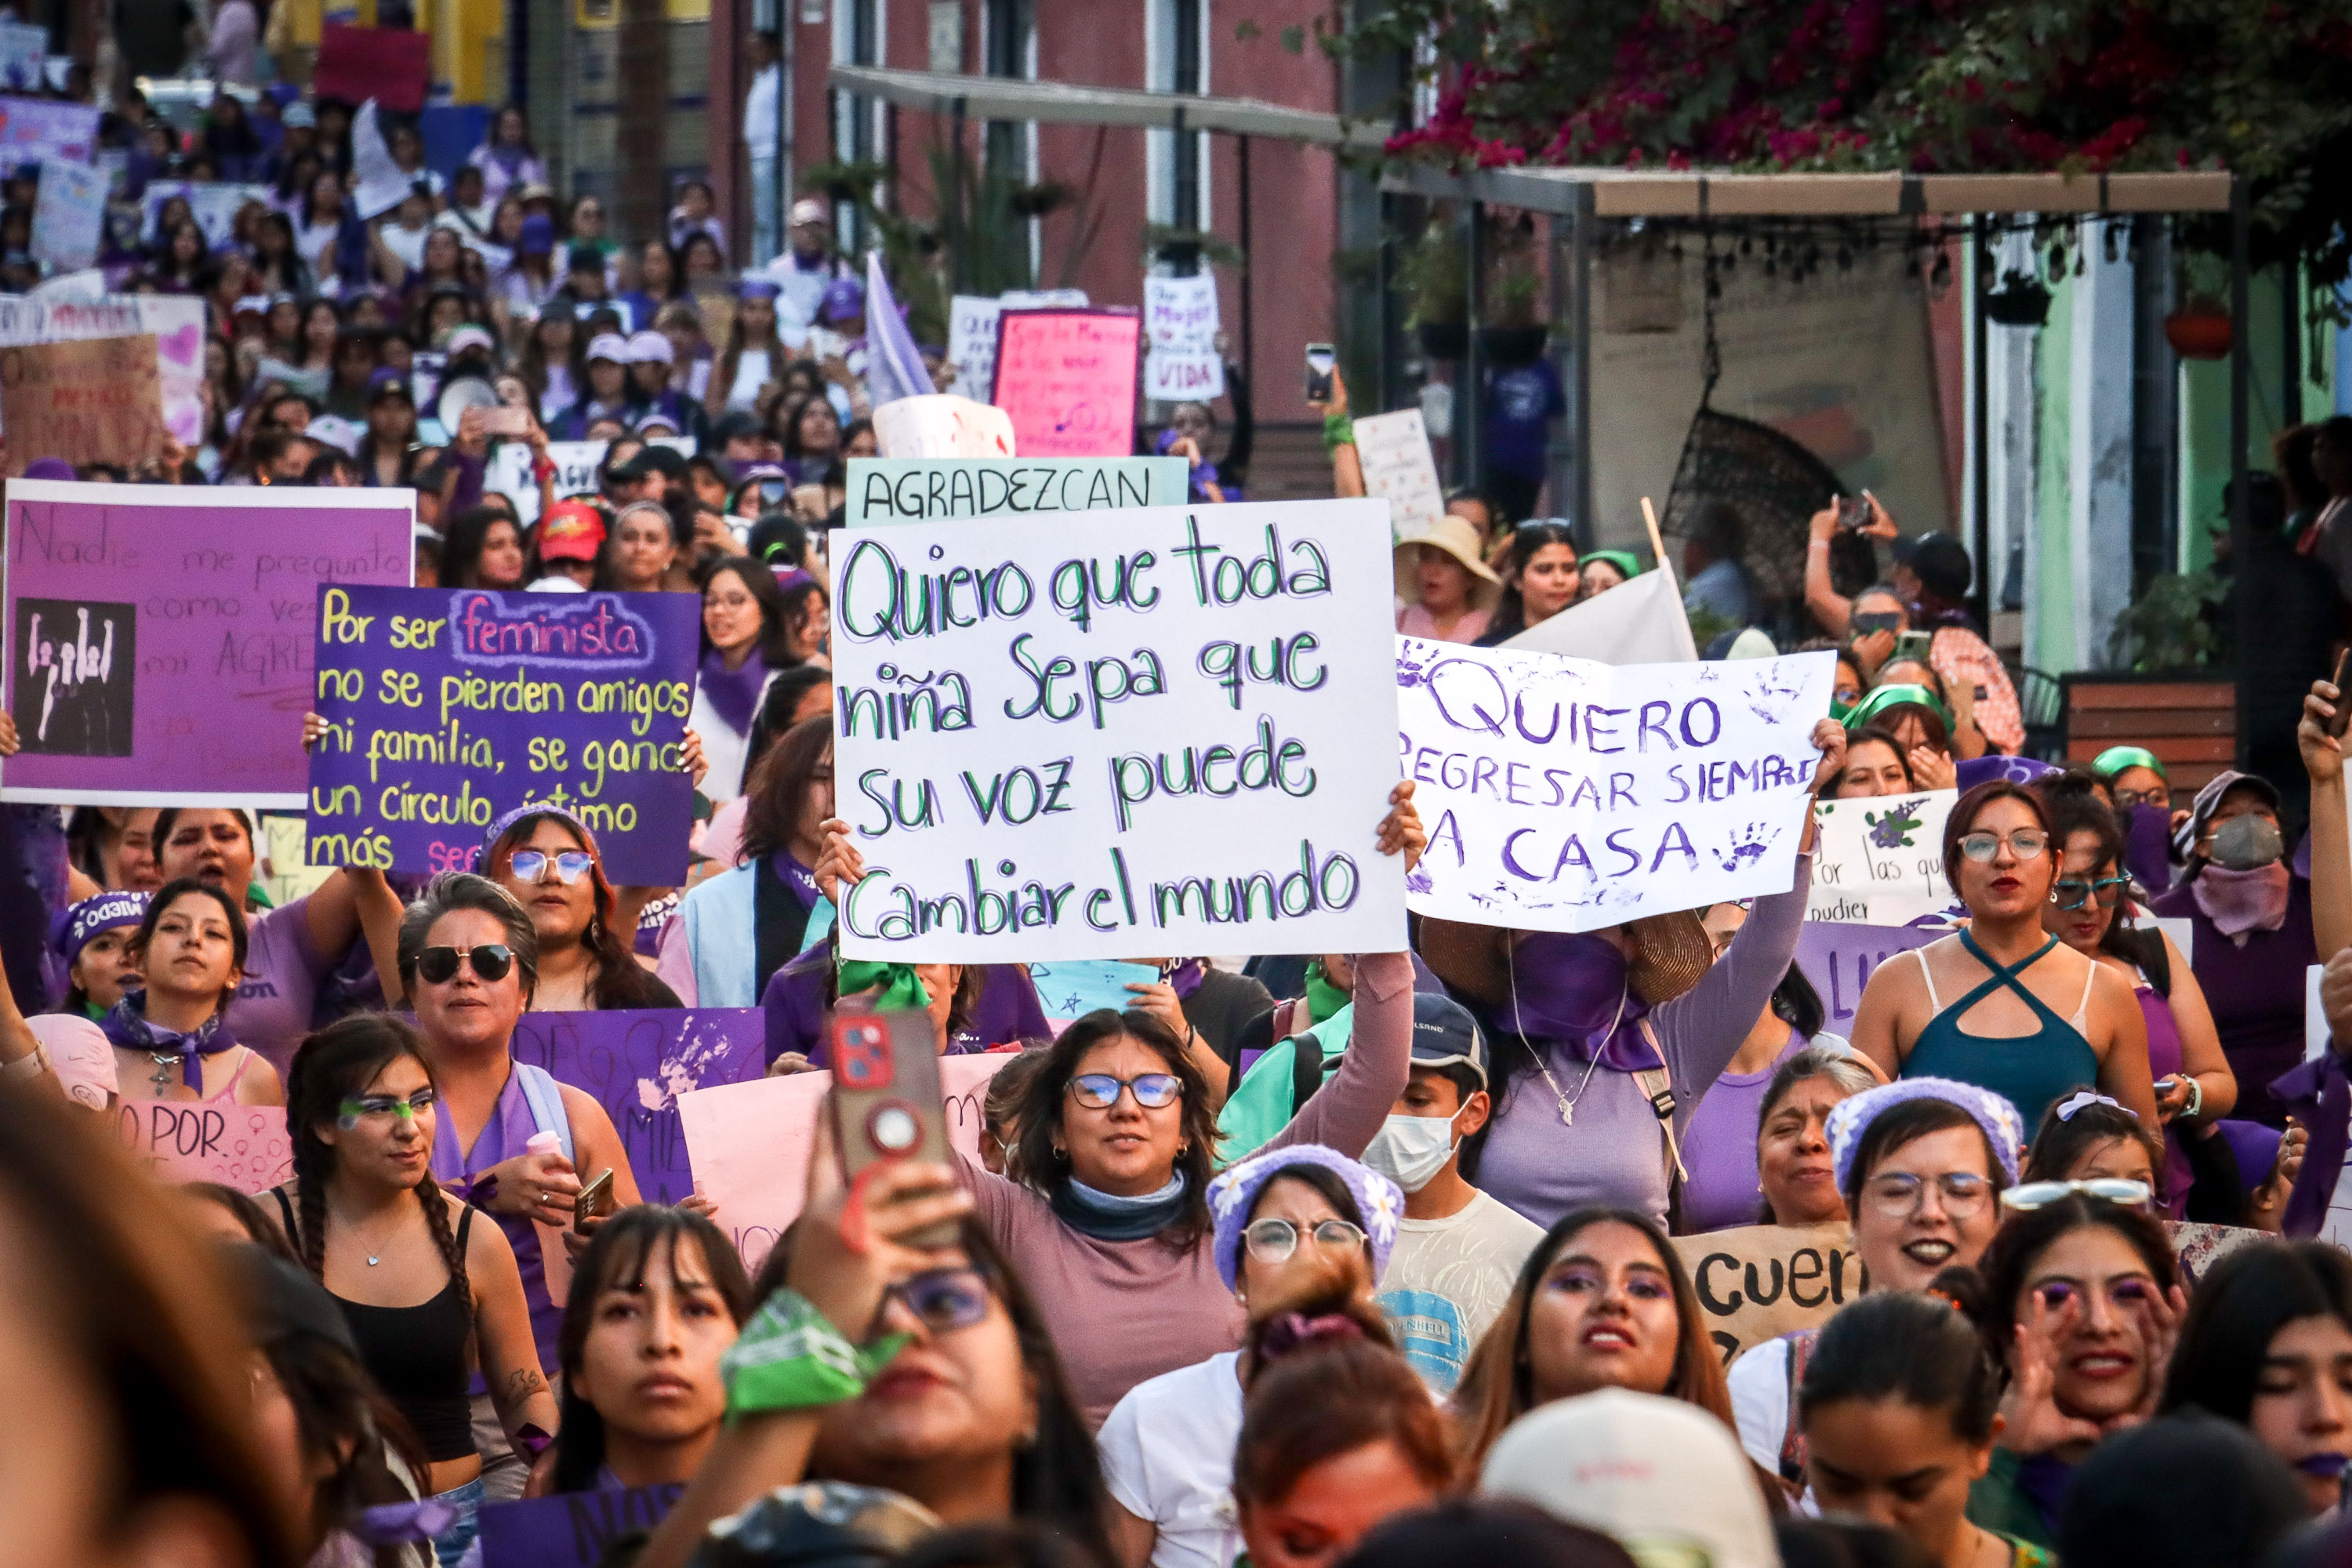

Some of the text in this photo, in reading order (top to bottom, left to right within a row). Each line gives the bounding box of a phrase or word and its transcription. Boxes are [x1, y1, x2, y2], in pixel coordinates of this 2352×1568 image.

[1157, 362, 1211, 390] VIDA
[863, 467, 1150, 519] AGRADEZCAN
[16, 503, 140, 569] Nadie
[182, 548, 236, 572] me
[145, 597, 241, 620] como
[837, 514, 1333, 645] Quiero que toda
[322, 587, 640, 655] Por ser feminista
[318, 666, 690, 736] no se pierden amigos
[837, 662, 978, 741] niña
[1196, 630, 1328, 710] que
[1426, 658, 1722, 754] QUIERO
[320, 717, 681, 797] ni familia, se gana
[958, 755, 1077, 826] voz
[1107, 713, 1317, 833] puede
[312, 780, 637, 833] un círculo ítimo
[311, 827, 394, 870] más
[1425, 809, 1700, 885] A CASA
[1862, 833, 1902, 880] las
[1918, 855, 1944, 898] qu
[86, 900, 143, 927] MIEDO
[1083, 847, 1138, 932] el
[1149, 839, 1361, 928] mundo
